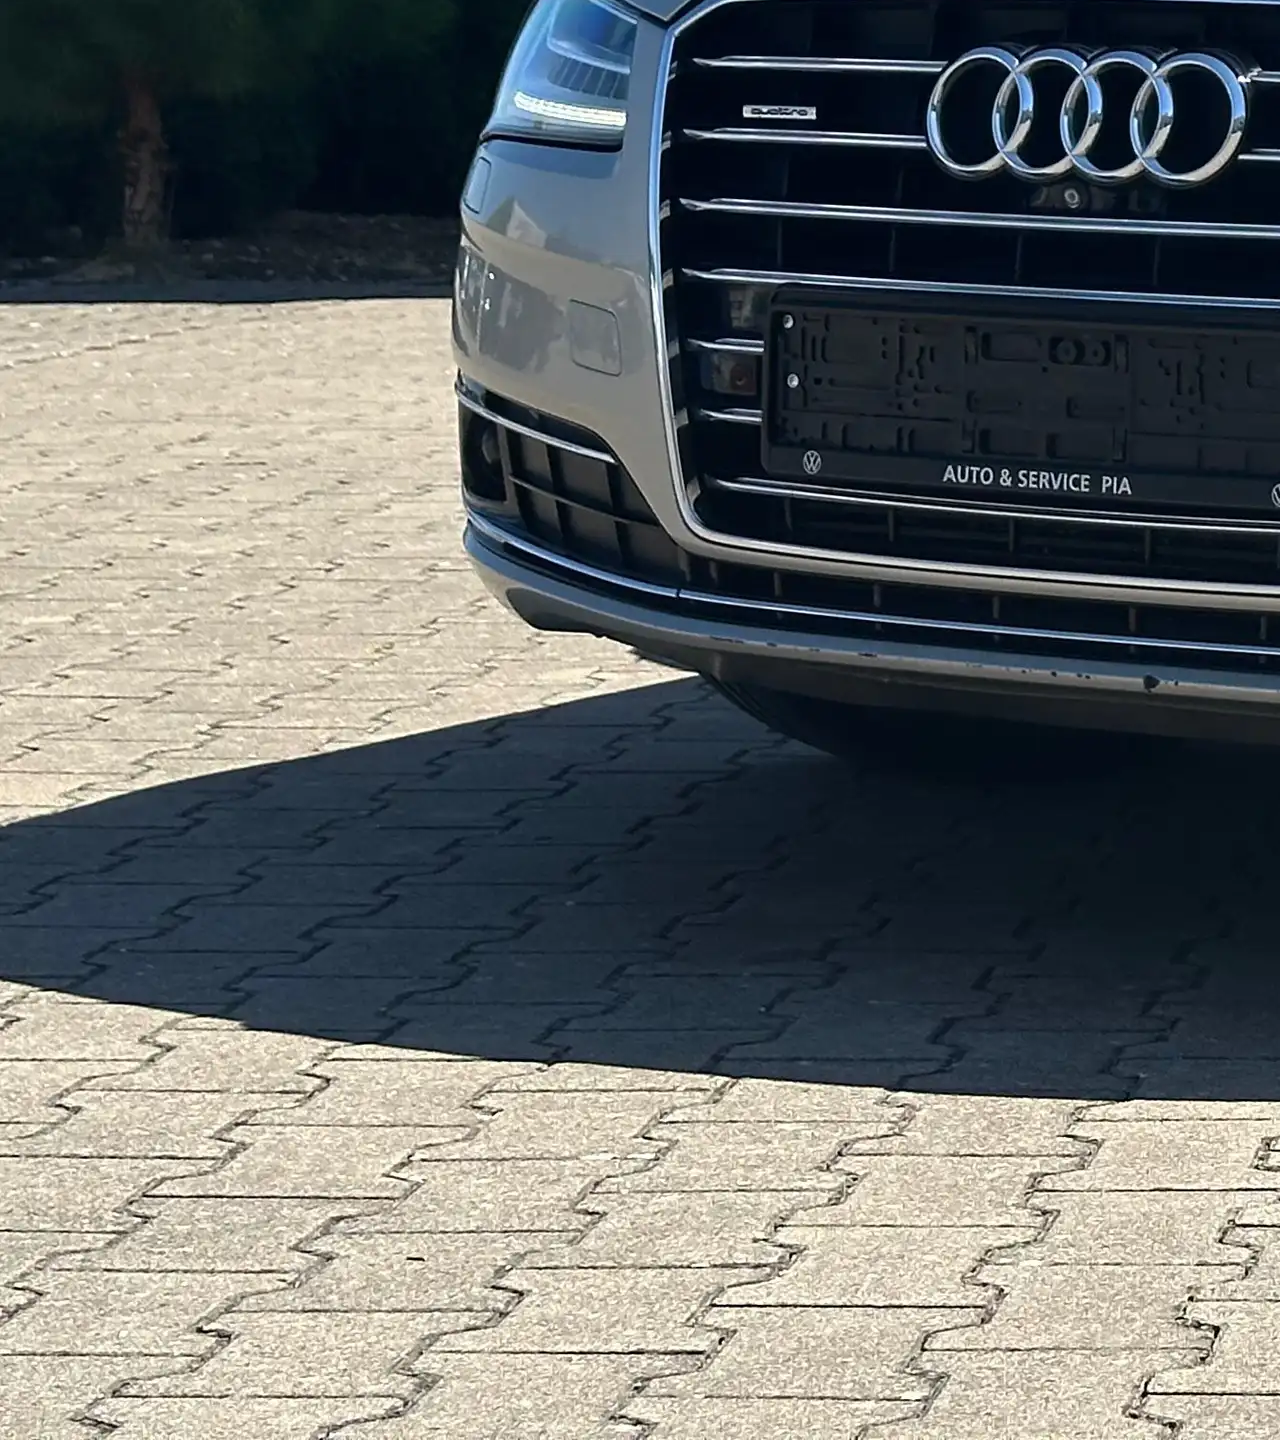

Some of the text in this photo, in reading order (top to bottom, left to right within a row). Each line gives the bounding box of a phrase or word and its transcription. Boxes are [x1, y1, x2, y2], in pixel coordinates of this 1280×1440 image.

[942, 464, 1132, 496] AUTO & SERVICE PIA
